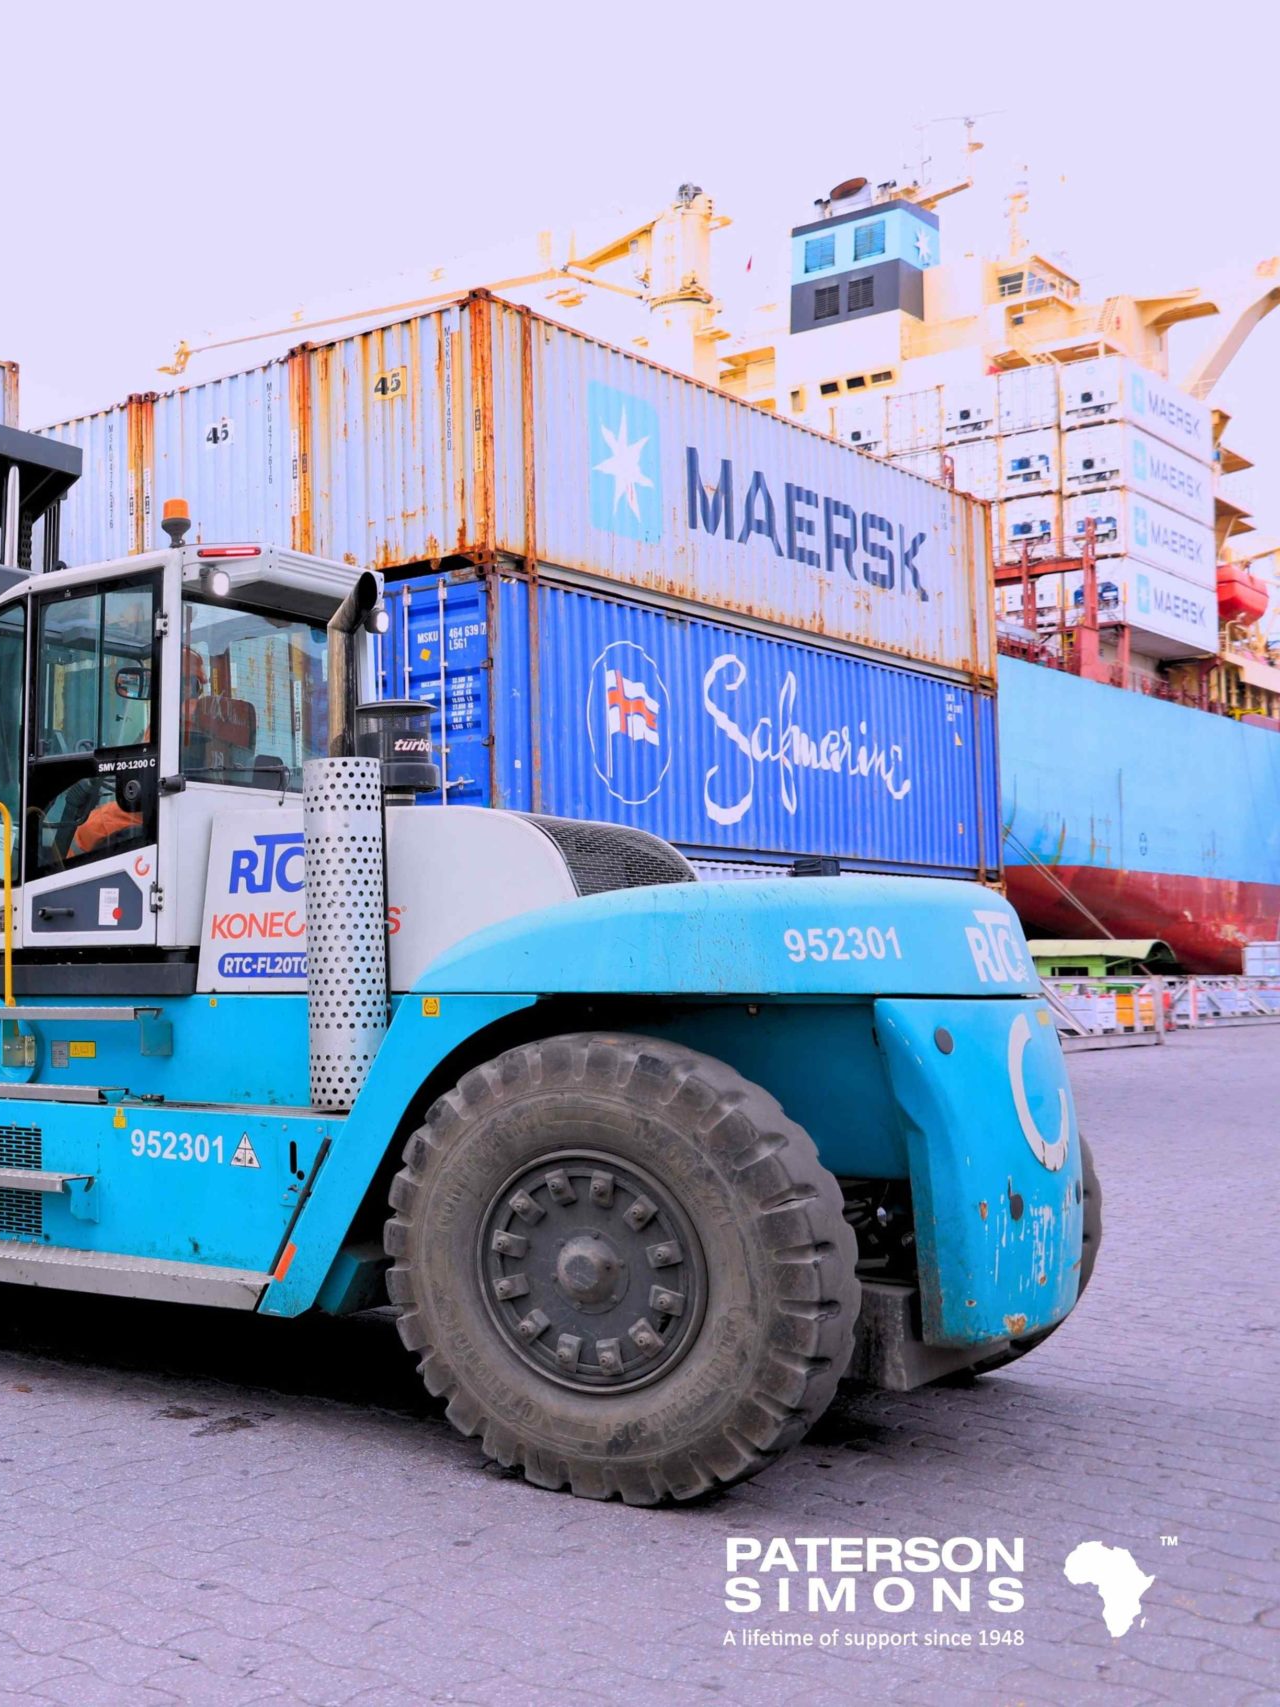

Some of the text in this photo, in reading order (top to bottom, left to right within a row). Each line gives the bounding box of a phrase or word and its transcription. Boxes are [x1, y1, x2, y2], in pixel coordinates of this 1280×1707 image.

[374, 372, 401, 395] 45
[206, 423, 229, 444] 45
[1149, 389, 1201, 440] MAERSK
[1150, 456, 1202, 500] MAERSK
[686, 446, 929, 602] MAERSK
[1151, 520, 1203, 565] MAERSK
[1153, 587, 1206, 628] MAERSK
[417, 631, 439, 644] MSKU
[449, 627, 462, 639] 464
[464, 624, 479, 636] 639
[704, 654, 911, 825] Safmarine
[98, 758, 156, 772] SMV 20-1200 C
[229, 833, 305, 894] RTC
[783, 926, 903, 963] 952301
[130, 1129, 224, 1164] 952301
